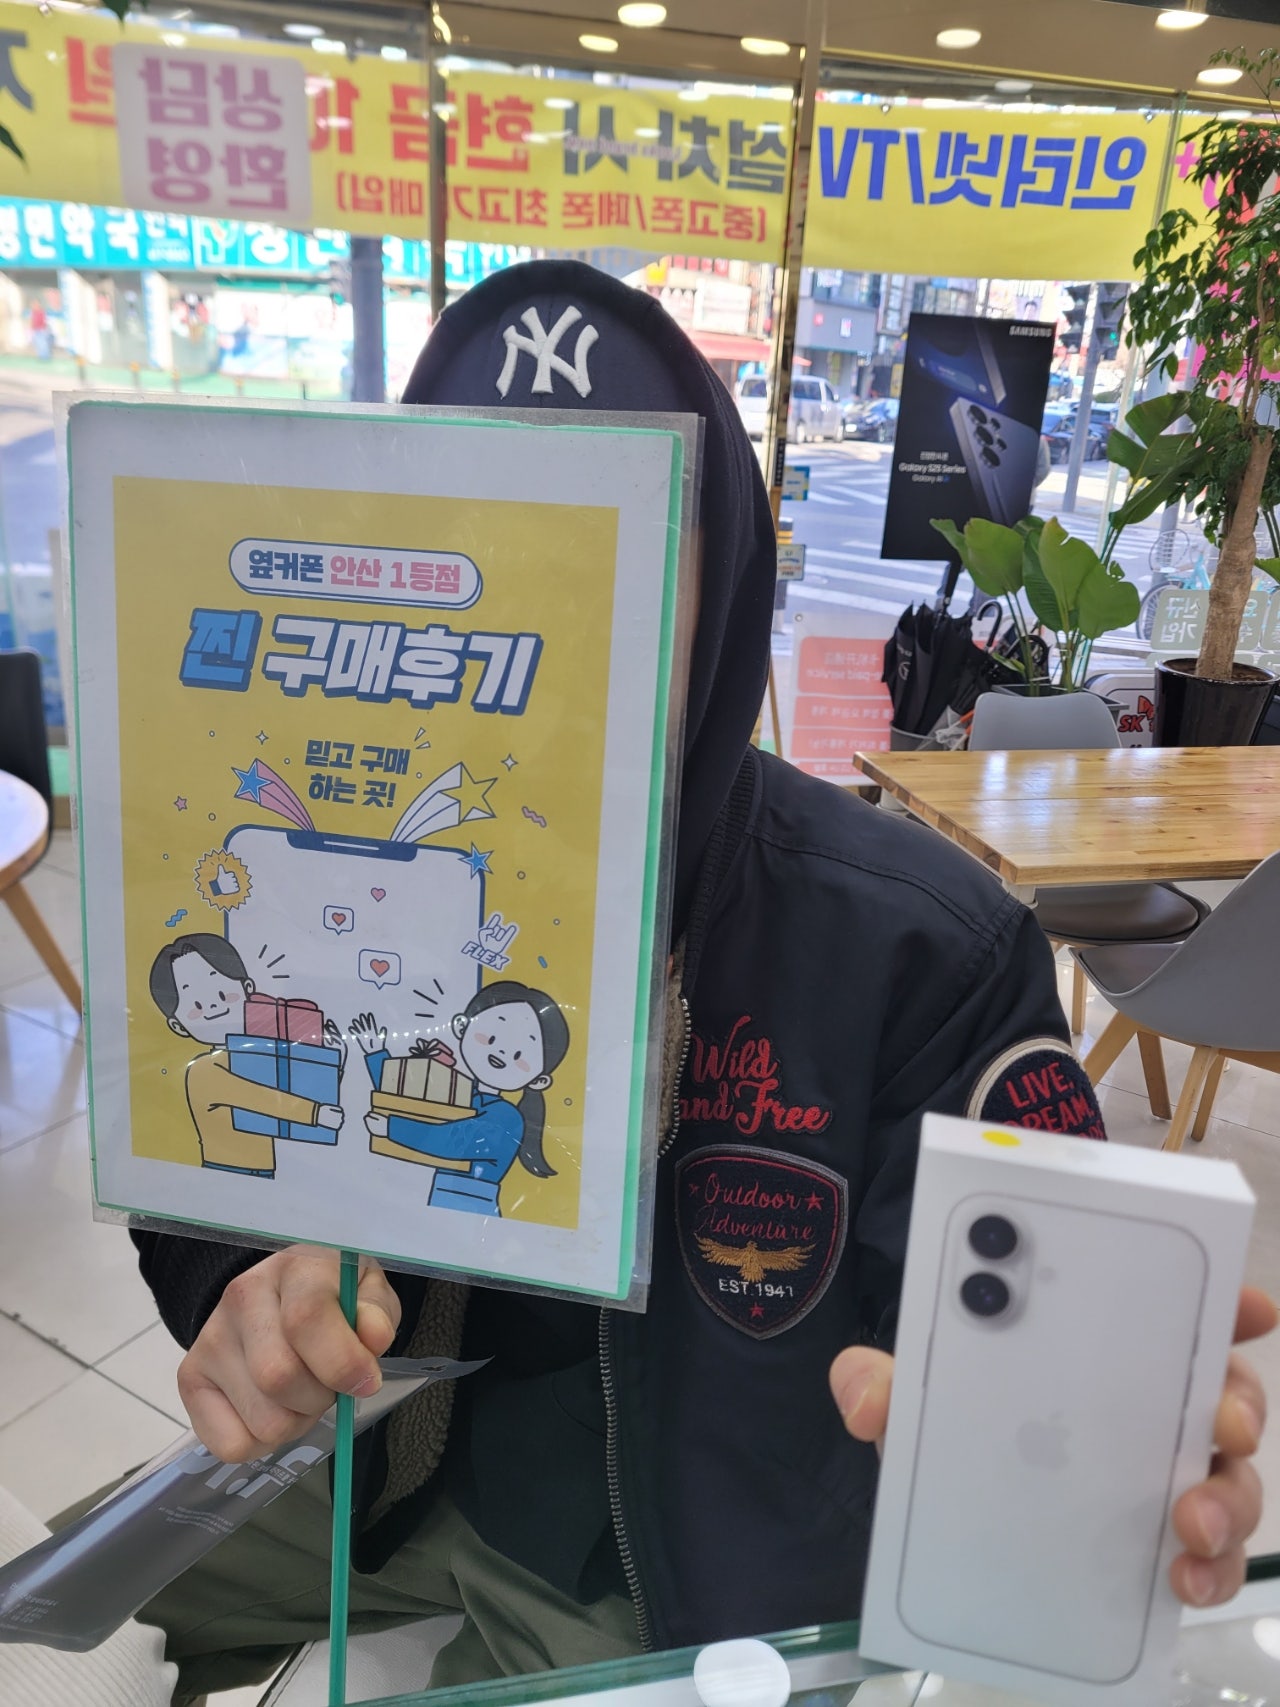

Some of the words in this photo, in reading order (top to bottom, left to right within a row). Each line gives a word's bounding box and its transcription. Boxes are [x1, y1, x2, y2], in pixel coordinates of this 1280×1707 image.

[1009, 325, 1053, 338] SAMSUNG
[496, 305, 600, 398] NY
[898, 462, 927, 474] Galaxy
[942, 464, 967, 474] Series
[249, 549, 324, 584] 옆커폰
[330, 555, 383, 588] 안산
[390, 561, 461, 594] 1등점
[179, 608, 263, 692] 찐
[262, 614, 544, 716] 구매후기
[1117, 714, 1146, 733] SK
[304, 740, 355, 769] 믿고
[360, 745, 411, 775] 구매
[308, 773, 358, 804] 하는
[363, 780, 397, 809] 곳!
[460, 940, 510, 971] FLEX
[691, 1015, 779, 1083] Wild
[1005, 1061, 1075, 1109] LIVE,
[734, 1078, 830, 1135] Free
[704, 1172, 800, 1209] Outdoor
[695, 1205, 815, 1241] Adventure
